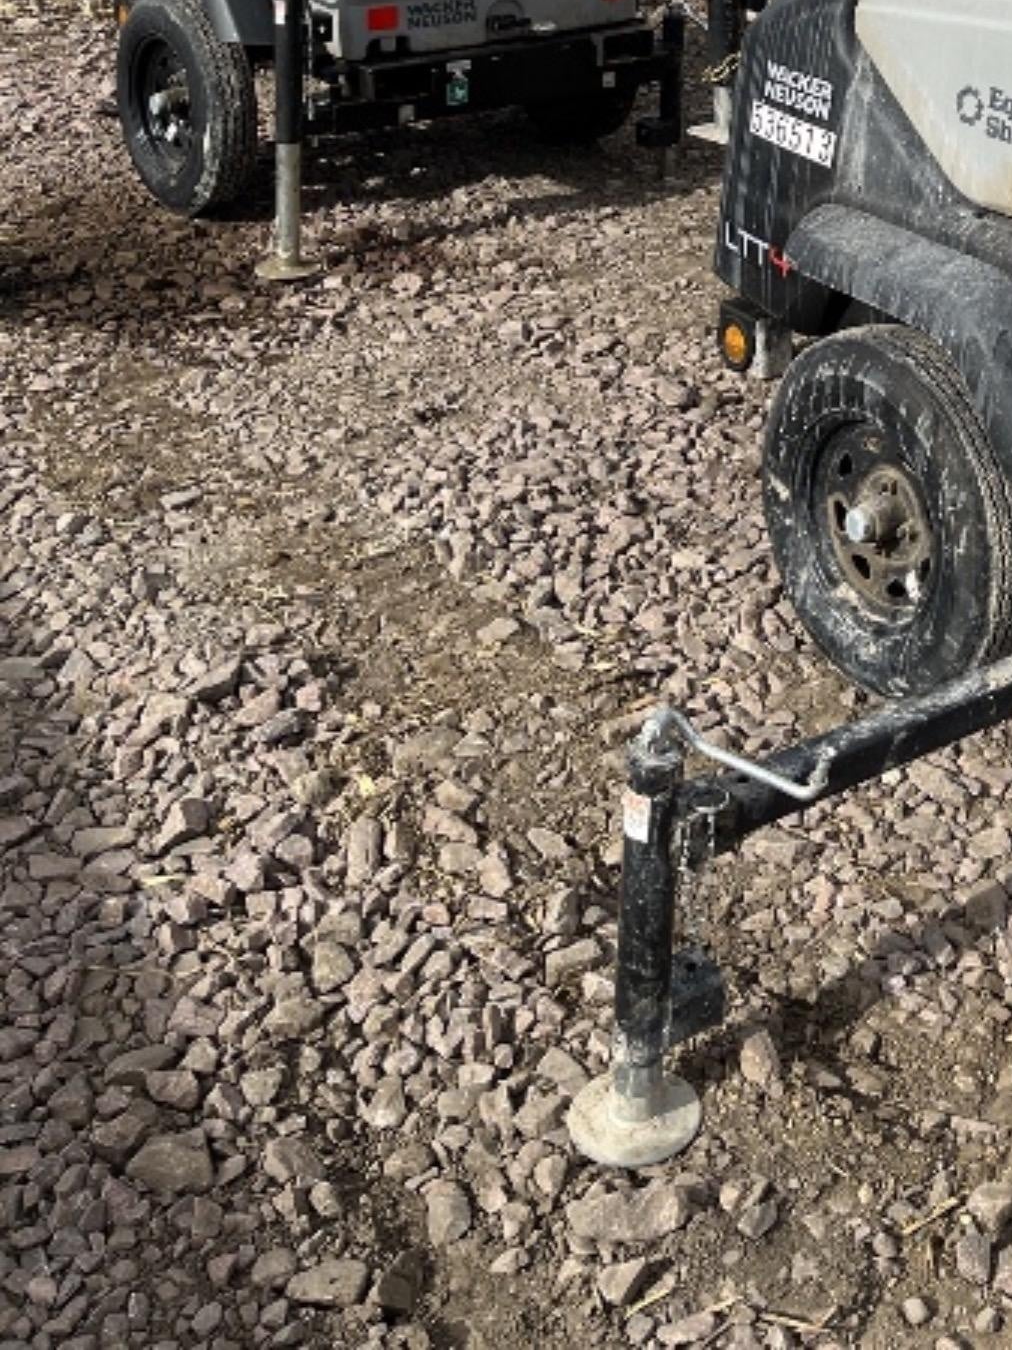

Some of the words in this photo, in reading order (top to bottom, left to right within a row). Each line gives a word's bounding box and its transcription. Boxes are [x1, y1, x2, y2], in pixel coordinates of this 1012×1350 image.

[406, 10, 478, 30] NEUSON
[767, 58, 833, 100] WACKER
[764, 80, 833, 122] NEUSON
[751, 102, 833, 163] 536513
[724, 220, 791, 280] LTT4
